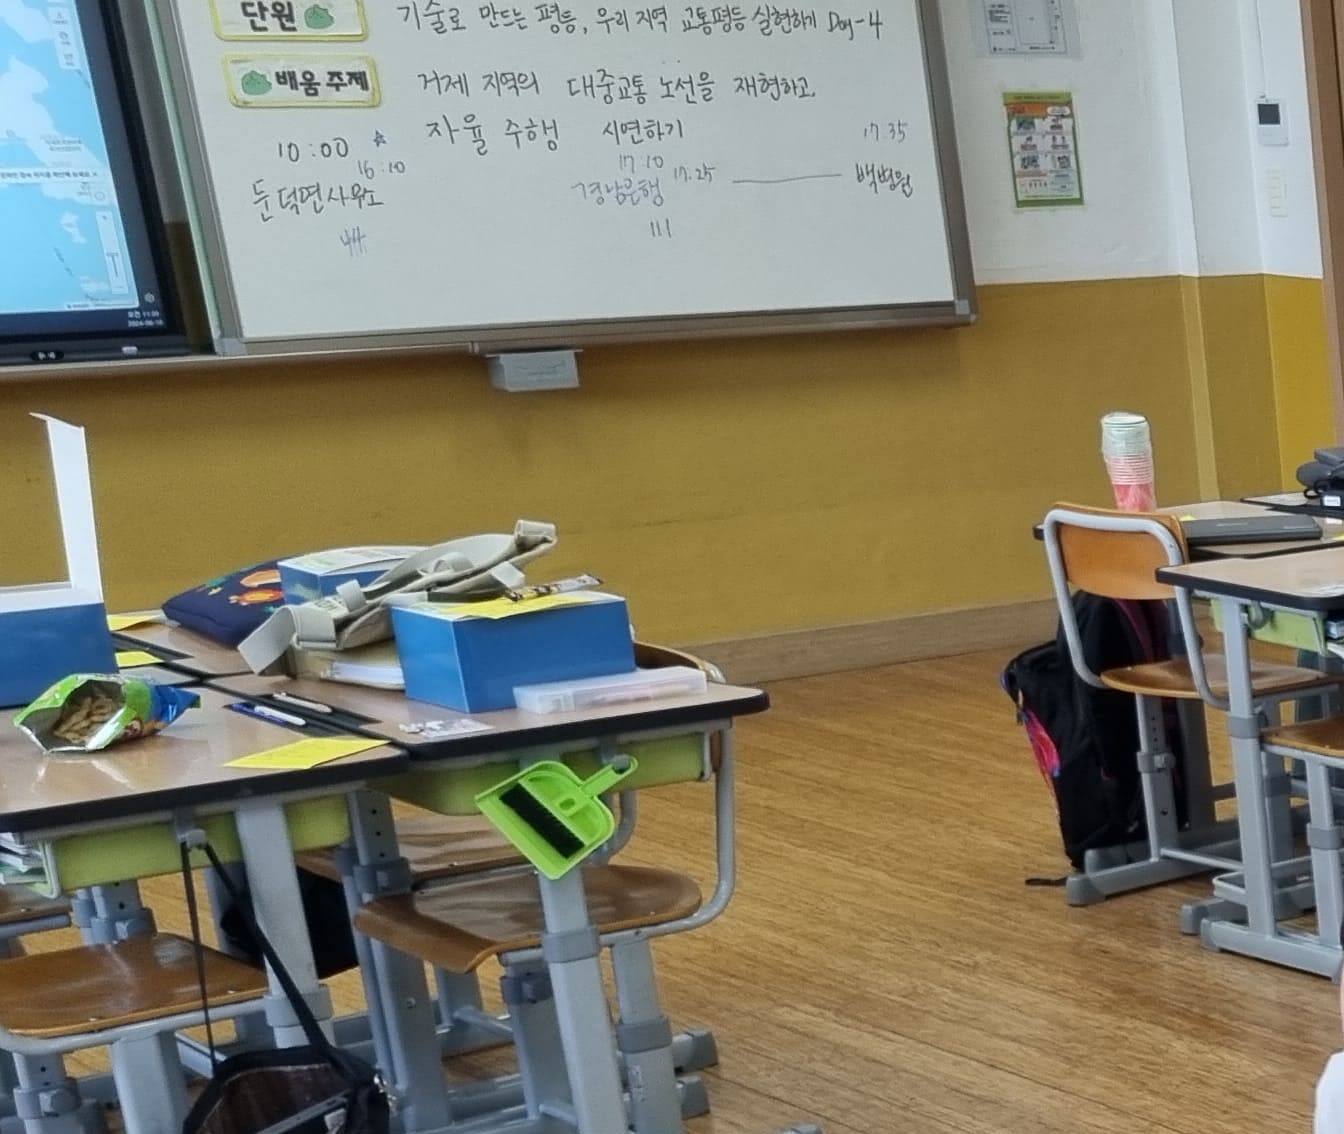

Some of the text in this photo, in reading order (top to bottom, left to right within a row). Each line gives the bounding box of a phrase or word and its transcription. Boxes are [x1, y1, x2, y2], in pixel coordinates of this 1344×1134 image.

[241, 1, 298, 32] 단원
[397, 0, 466, 34] 기술로
[480, 2, 528, 30] 만드는
[596, 7, 630, 34] 우리
[636, 5, 668, 33] 지역
[682, 6, 747, 36] 교통평등
[752, 3, 817, 37] 실현하기
[275, 70, 370, 97] 배움 주제
[417, 70, 470, 97] 거제
[482, 70, 540, 97] 지역의
[567, 68, 648, 104] 대중교통
[660, 71, 716, 104] 노선을
[426, 113, 685, 156] 자율 주행 시연하기
